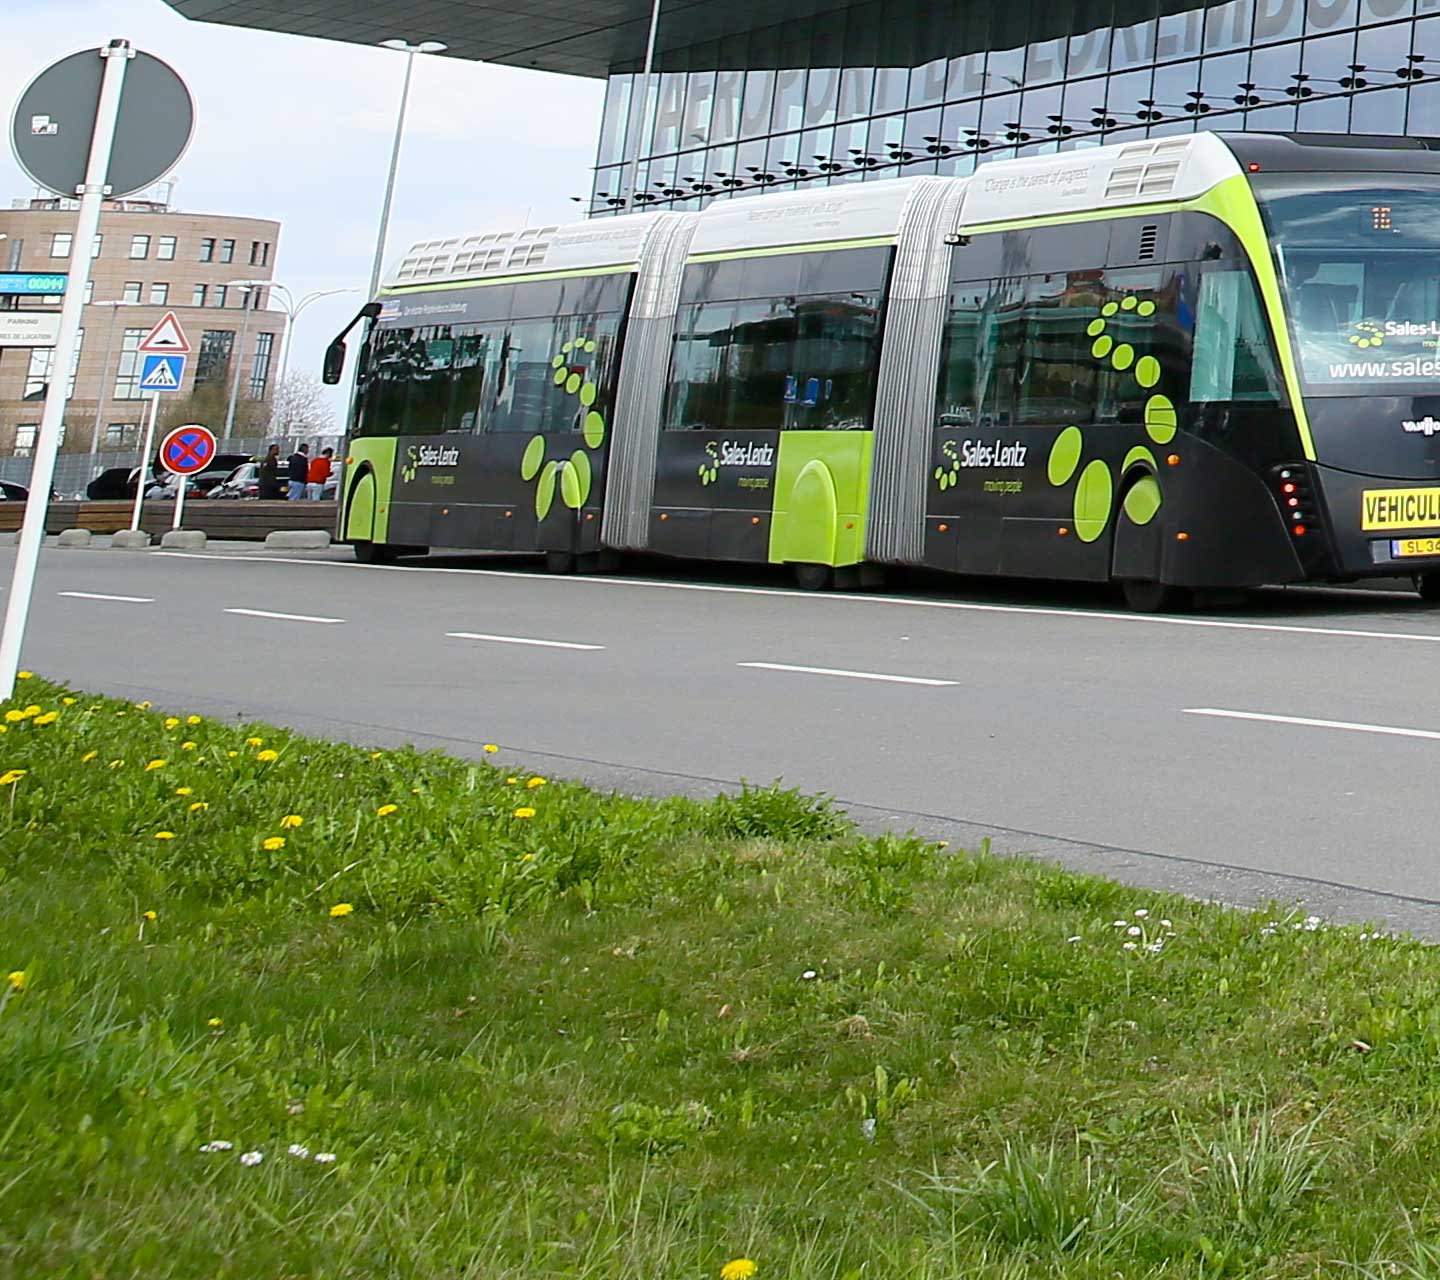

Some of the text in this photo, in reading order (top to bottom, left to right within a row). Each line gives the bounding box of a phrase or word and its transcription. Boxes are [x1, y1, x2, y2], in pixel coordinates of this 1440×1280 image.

[720, 440, 775, 466] Sales-Lentz
[961, 439, 1027, 467] Sales-Lentz
[1407, 541, 1423, 553] SL
